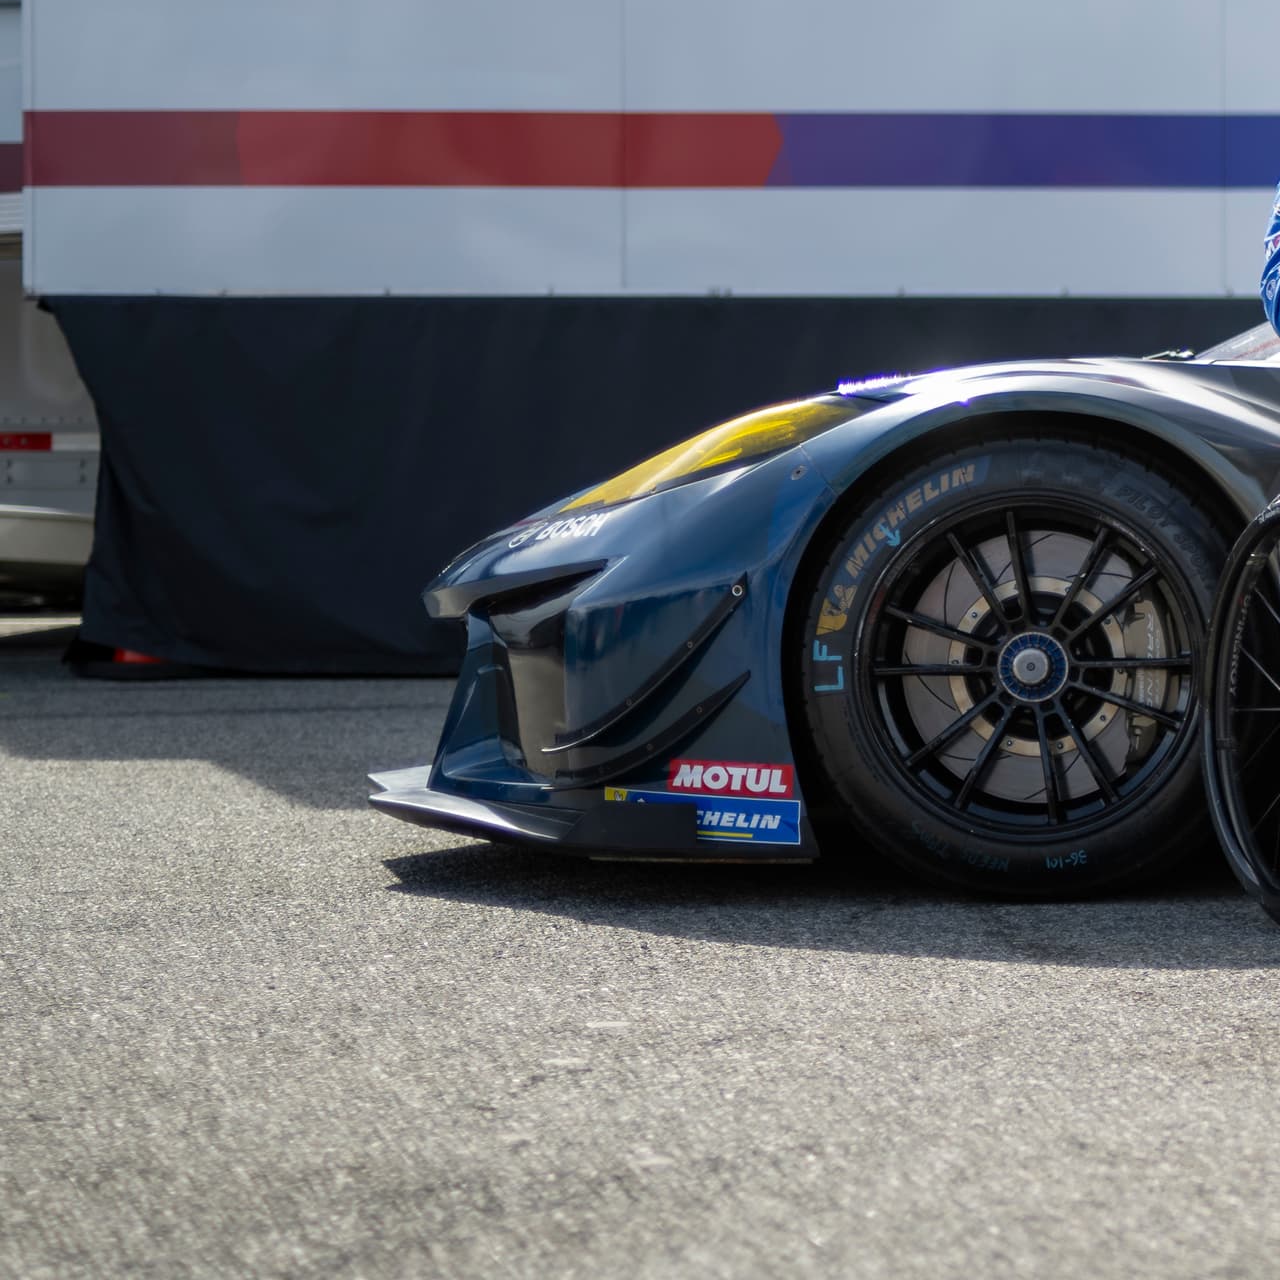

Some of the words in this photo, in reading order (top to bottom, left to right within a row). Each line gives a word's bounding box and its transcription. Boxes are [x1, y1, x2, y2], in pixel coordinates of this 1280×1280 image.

[535, 512, 610, 541] BOSCH
[844, 463, 977, 579] MICHELIN
[812, 639, 844, 692] LF
[671, 763, 788, 793] MOTUL
[696, 809, 782, 830] HELIN
[1045, 849, 1088, 870] 36-101
